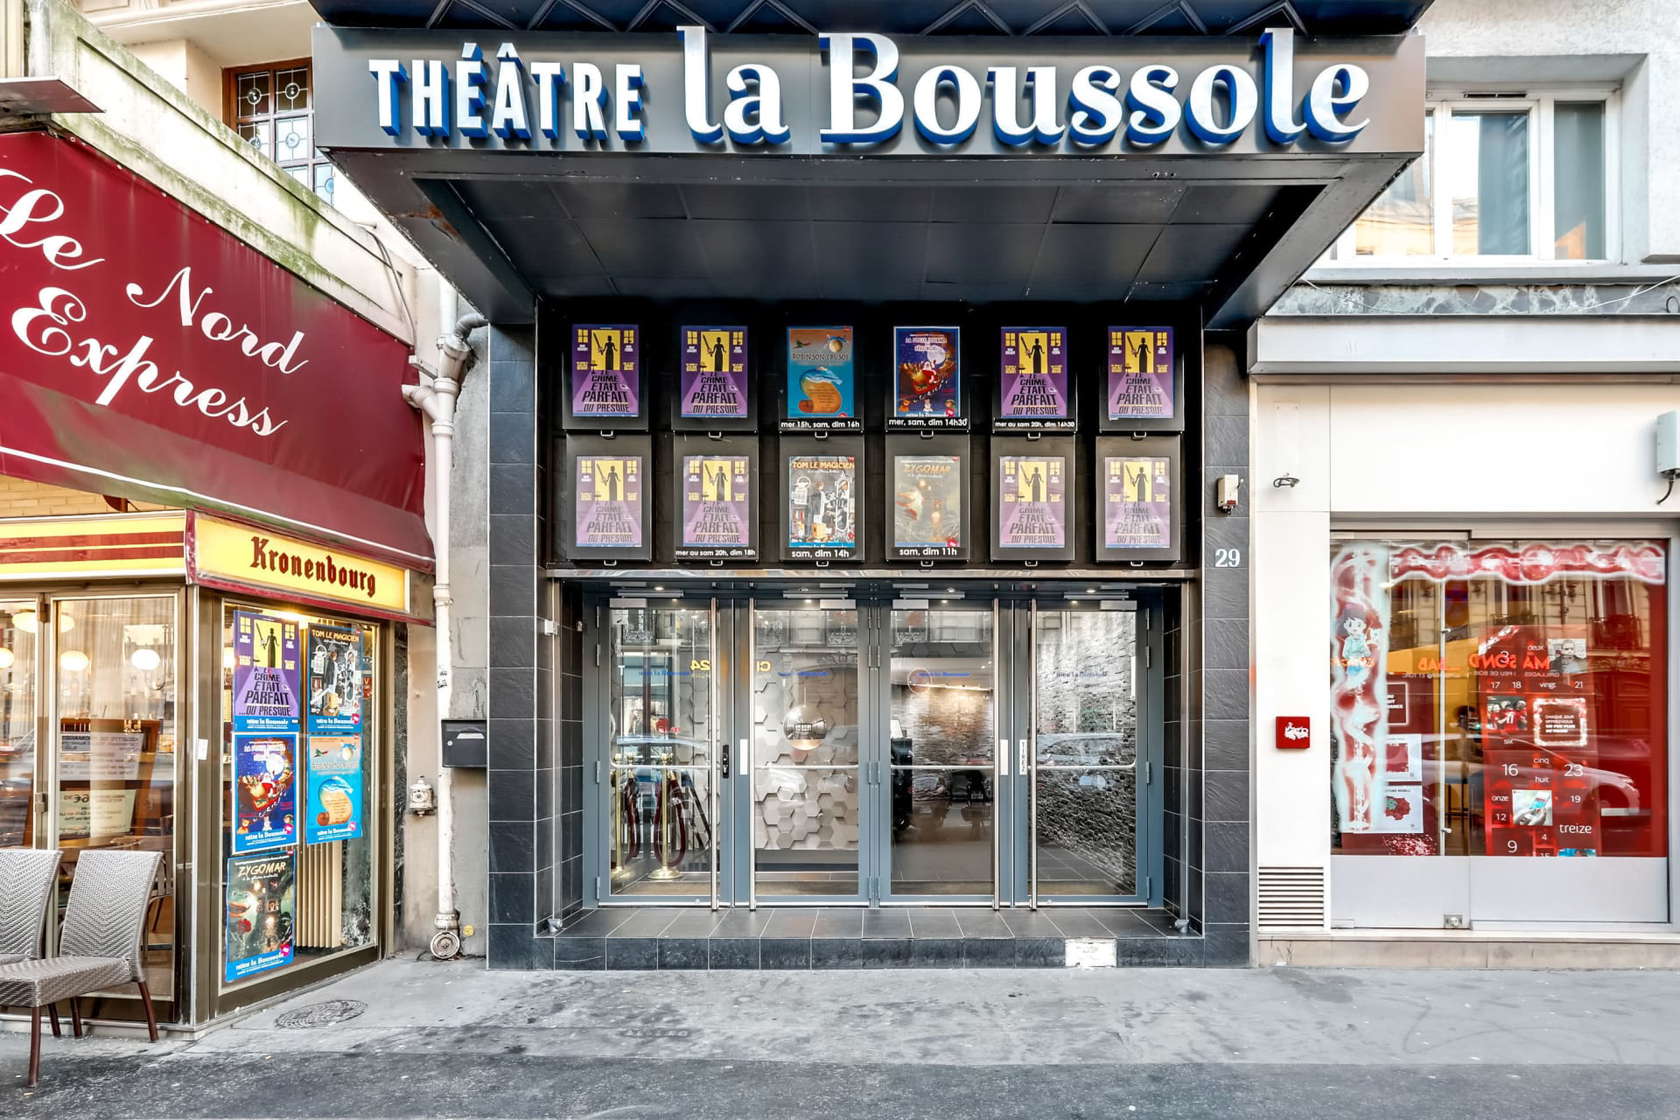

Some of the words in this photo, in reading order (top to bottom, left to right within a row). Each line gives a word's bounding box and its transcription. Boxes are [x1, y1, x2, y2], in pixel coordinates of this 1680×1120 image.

[368, 42, 645, 141] THÉÂTRE
[676, 25, 791, 144] la
[818, 28, 1370, 147] Boussole
[0, 168, 105, 270] Le
[126, 266, 309, 374] Nord
[11, 286, 288, 436] Express
[928, 418, 943, 426] dim
[945, 418, 968, 427] 14h30
[814, 550, 832, 558] dim
[834, 550, 850, 558] 14h
[922, 547, 940, 556] dim
[942, 547, 958, 556] 11h
[1215, 549, 1241, 567] 29
[250, 536, 376, 598] Kronenbourg
[311, 629, 325, 638] TOM
[325, 631, 334, 639] LE
[254, 672, 281, 681] CRIME
[1574, 681, 1584, 689] 21
[244, 689, 290, 706] PARFAIT
[258, 705, 292, 717] PRESQUE
[1501, 763, 1519, 776] 16
[1564, 763, 1584, 777] 23
[1570, 795, 1581, 803] 19
[1496, 813, 1507, 821] 12
[1559, 823, 1592, 834] treize
[1507, 840, 1518, 853] 9
[238, 861, 287, 877] ZYGOMAR
